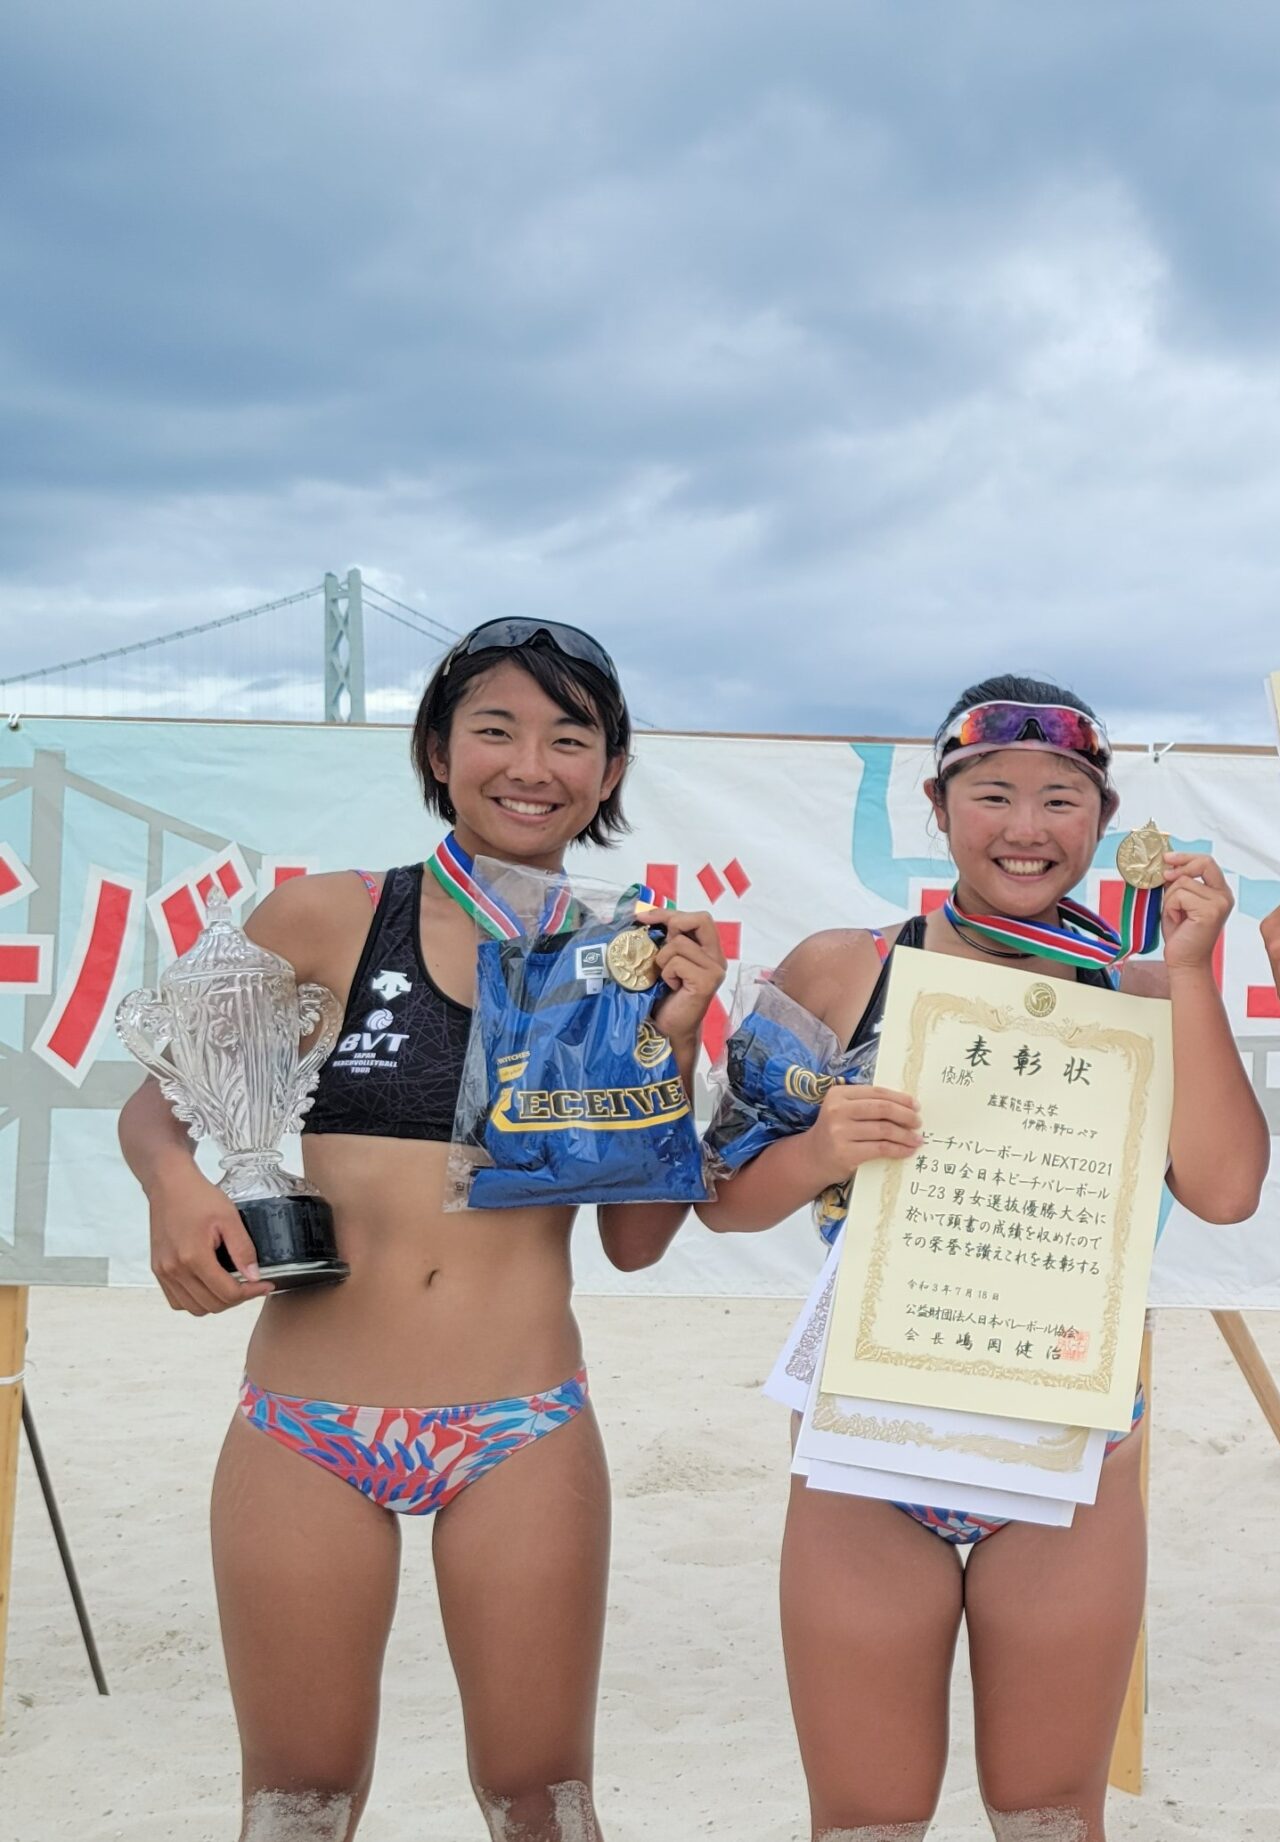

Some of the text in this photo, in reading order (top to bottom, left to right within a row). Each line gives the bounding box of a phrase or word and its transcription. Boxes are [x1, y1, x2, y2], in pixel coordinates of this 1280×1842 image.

[338, 1032, 410, 1053] BVT
[965, 1034, 1092, 1086] 表彰状
[942, 1066, 975, 1087] 優勝
[1041, 1153, 1113, 1176] NEXT2021
